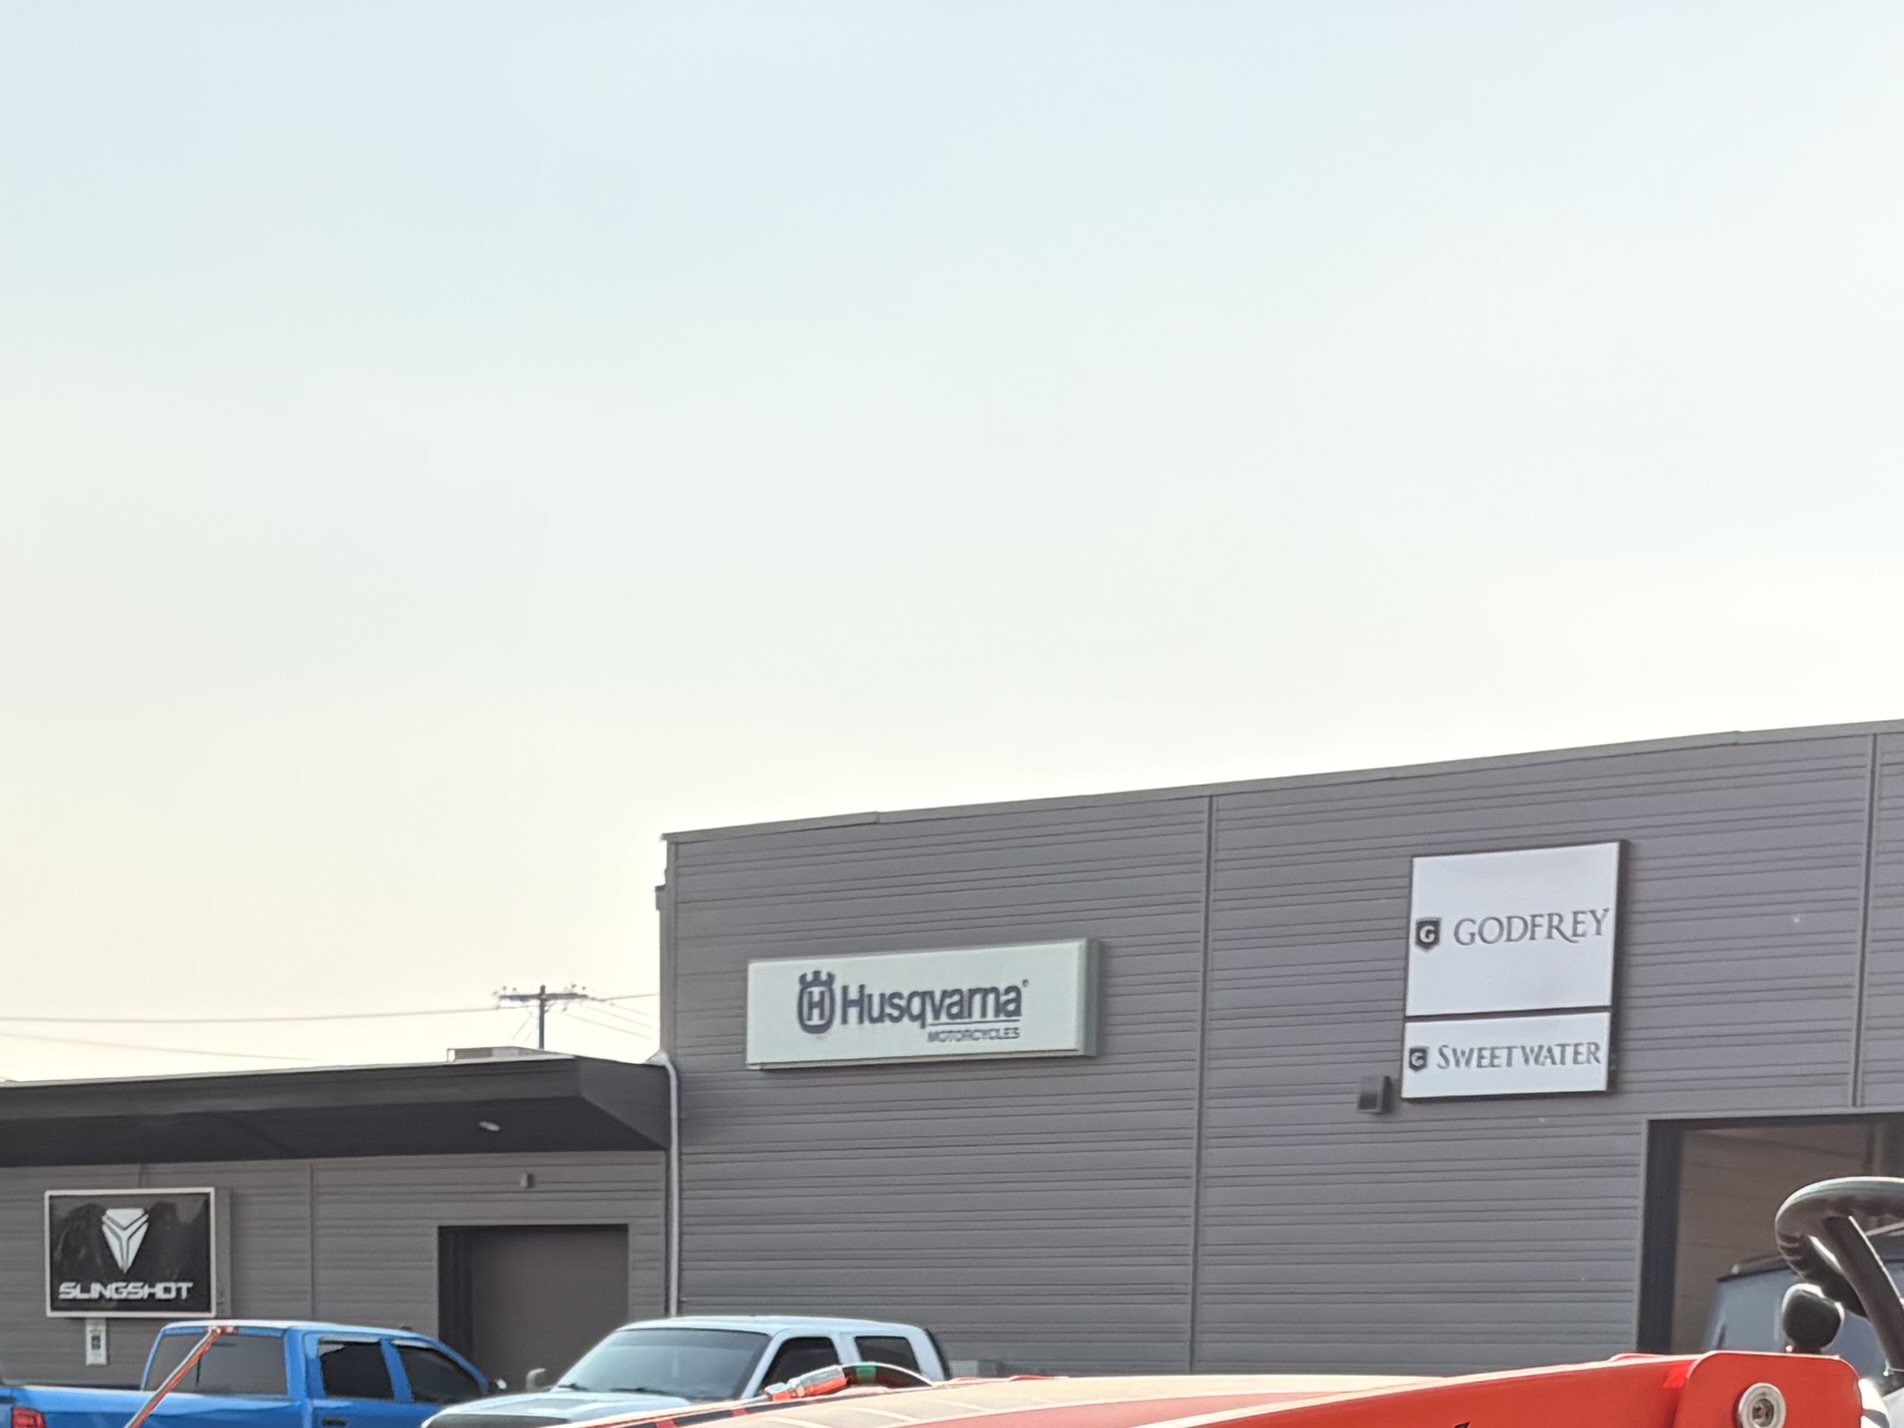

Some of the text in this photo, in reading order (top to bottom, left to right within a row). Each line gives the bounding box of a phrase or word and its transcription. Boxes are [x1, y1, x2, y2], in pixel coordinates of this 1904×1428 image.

[1453, 907, 1610, 946] GODFREY
[840, 982, 1022, 1030] Husqvarna
[927, 1026, 1021, 1043] MOTORCYCLES
[1436, 1041, 1602, 1069] SWEETWATER
[58, 1281, 194, 1300] SLINGSHOT
